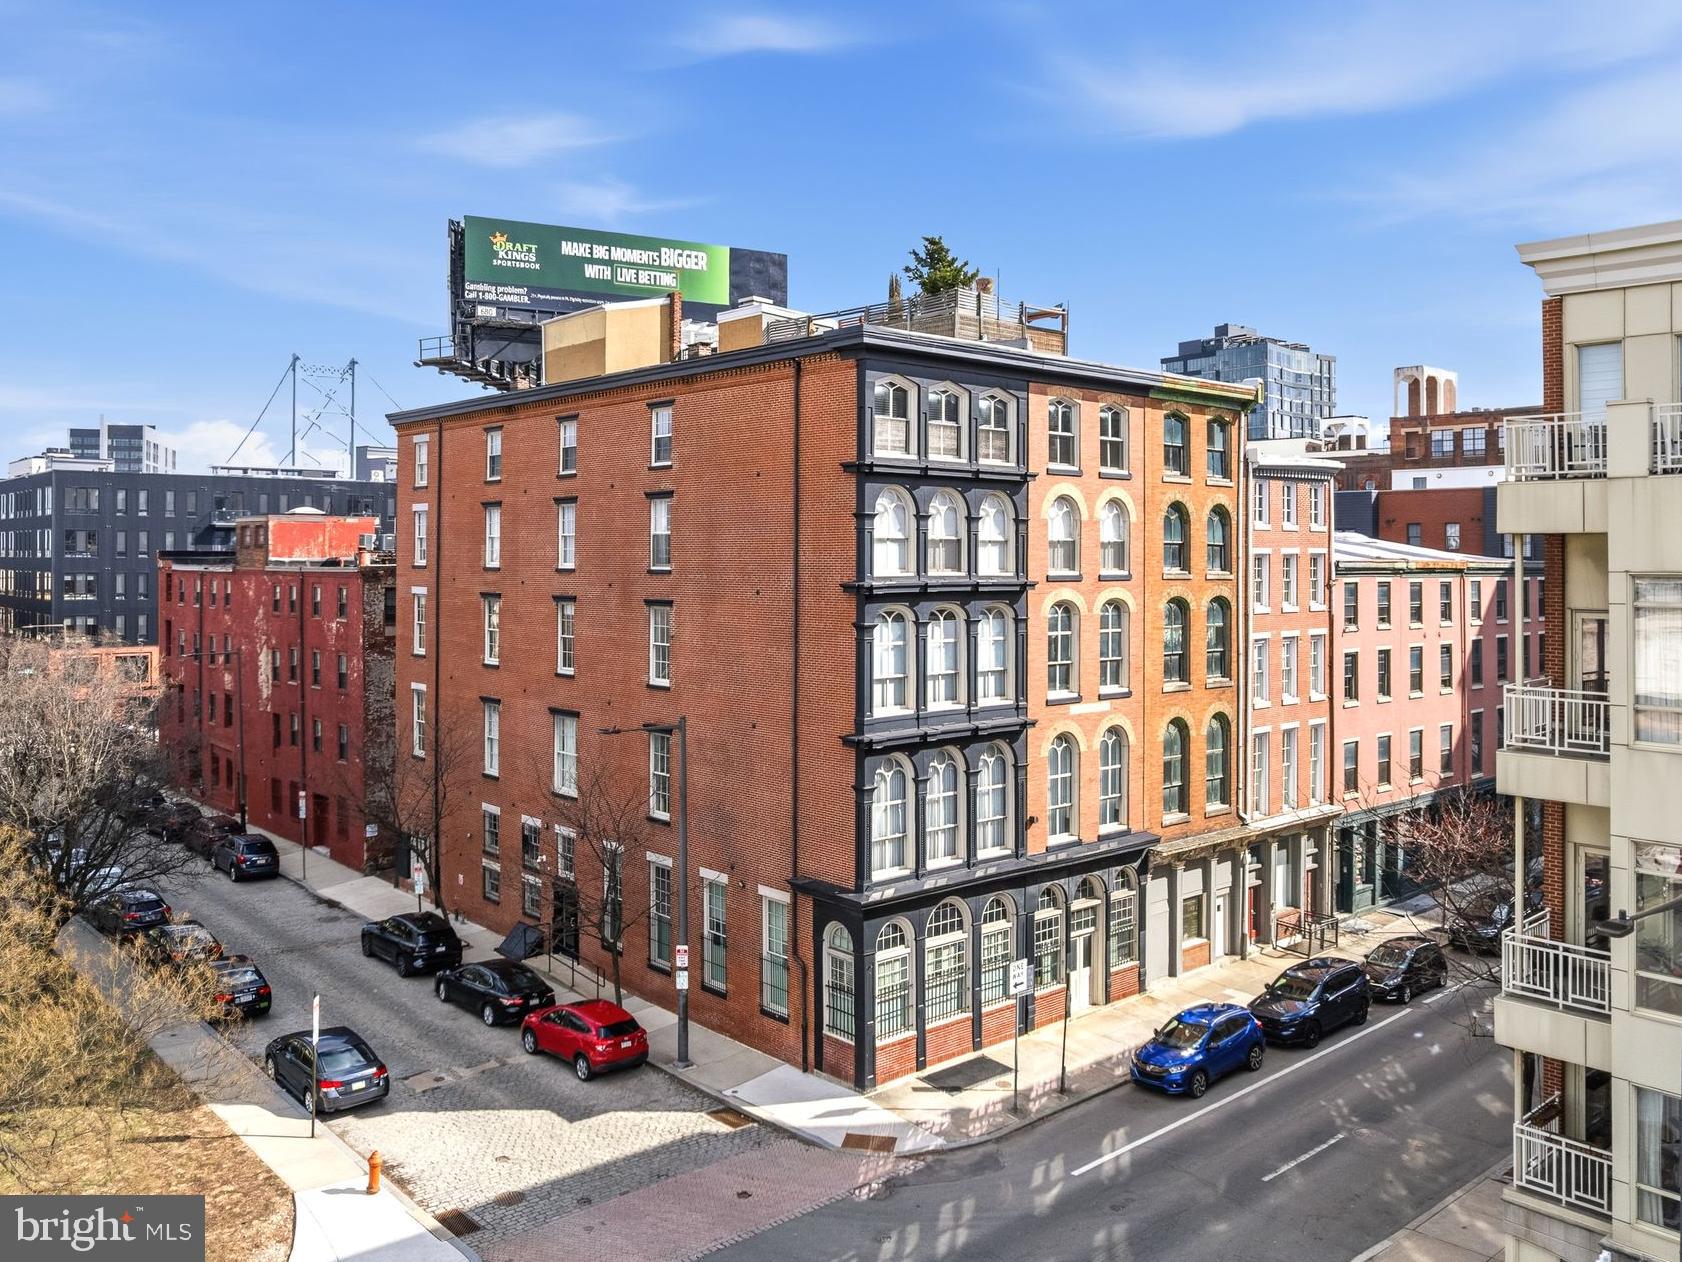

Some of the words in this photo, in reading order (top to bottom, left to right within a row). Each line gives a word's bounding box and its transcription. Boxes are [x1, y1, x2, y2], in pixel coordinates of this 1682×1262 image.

[492, 241, 538, 253] DRAFT
[498, 250, 536, 262] KINGS
[561, 240, 592, 258] MAKE
[592, 244, 610, 260] BIG
[610, 246, 660, 265] MOMENTS
[660, 247, 708, 271] BIGGER
[492, 259, 541, 270] SPORTSBOOK
[584, 263, 611, 280] WITH
[616, 267, 638, 284] LIVE
[638, 270, 677, 287] BETTING
[465, 282, 497, 293] Gambling
[497, 285, 528, 295] problem?
[465, 290, 477, 299] Call
